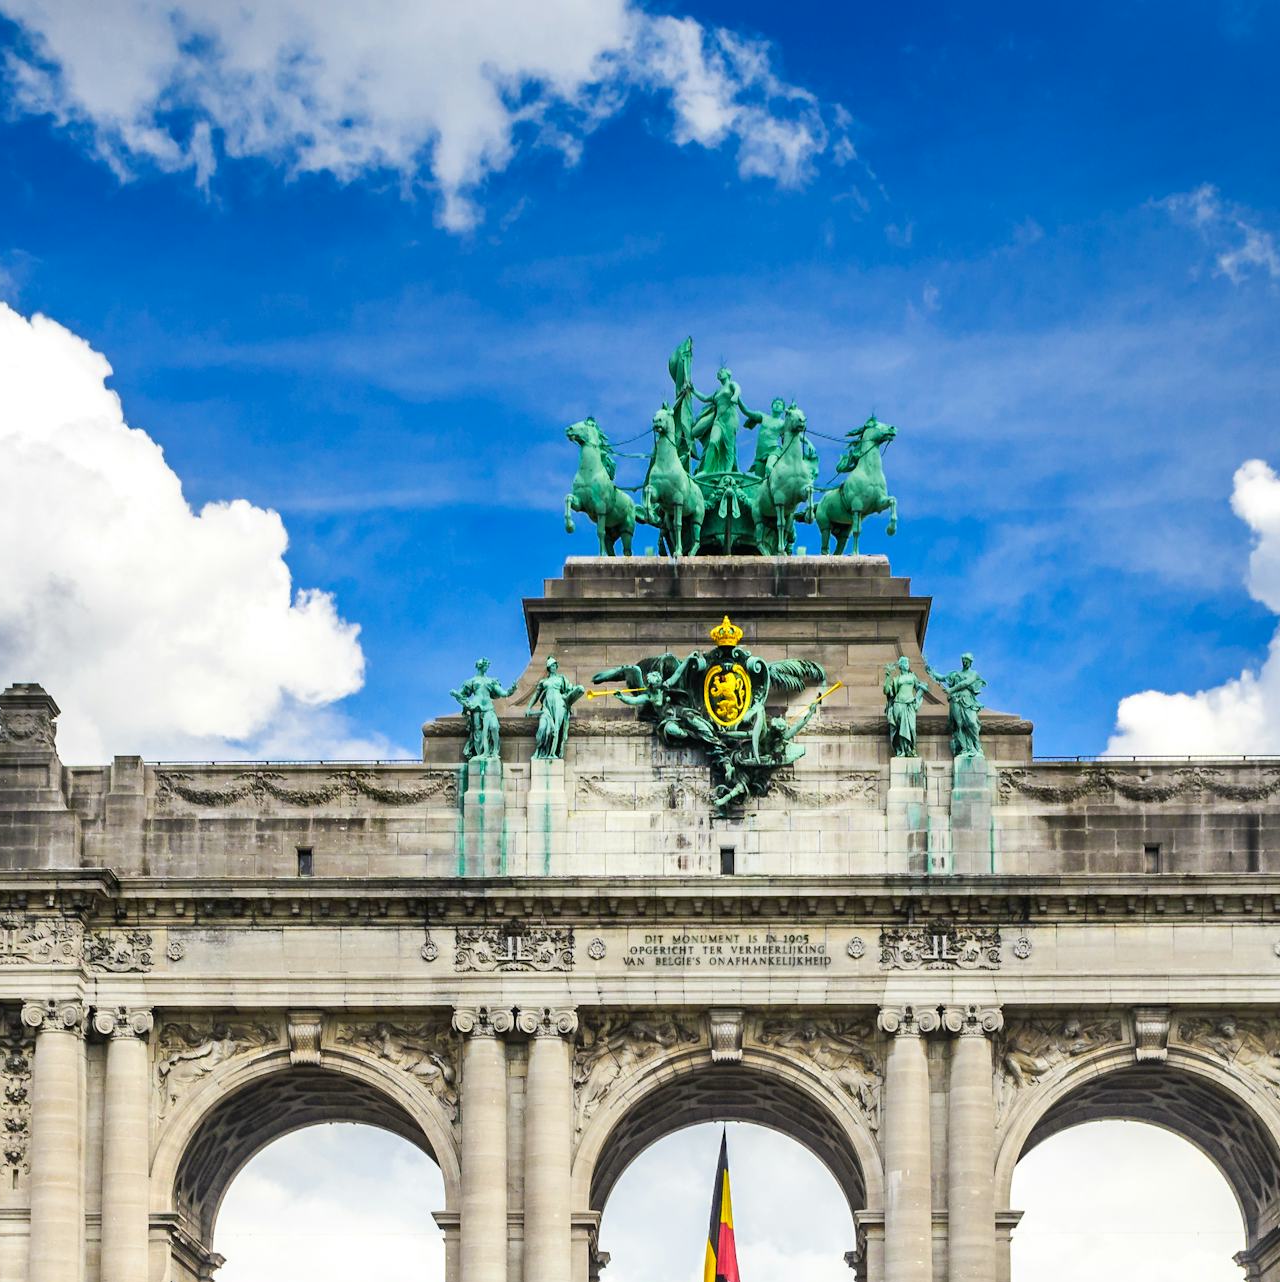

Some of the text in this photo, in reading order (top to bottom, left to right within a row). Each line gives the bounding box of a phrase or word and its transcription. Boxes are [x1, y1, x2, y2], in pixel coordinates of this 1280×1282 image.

[644, 934, 809, 944] DIT MONUMENT IS IN 1905
[629, 945, 825, 956] OPGERICHT TER VERHEERLIJKING
[623, 957, 645, 966] VAN
[709, 956, 832, 967] ONAFHANKELIJKHEID
